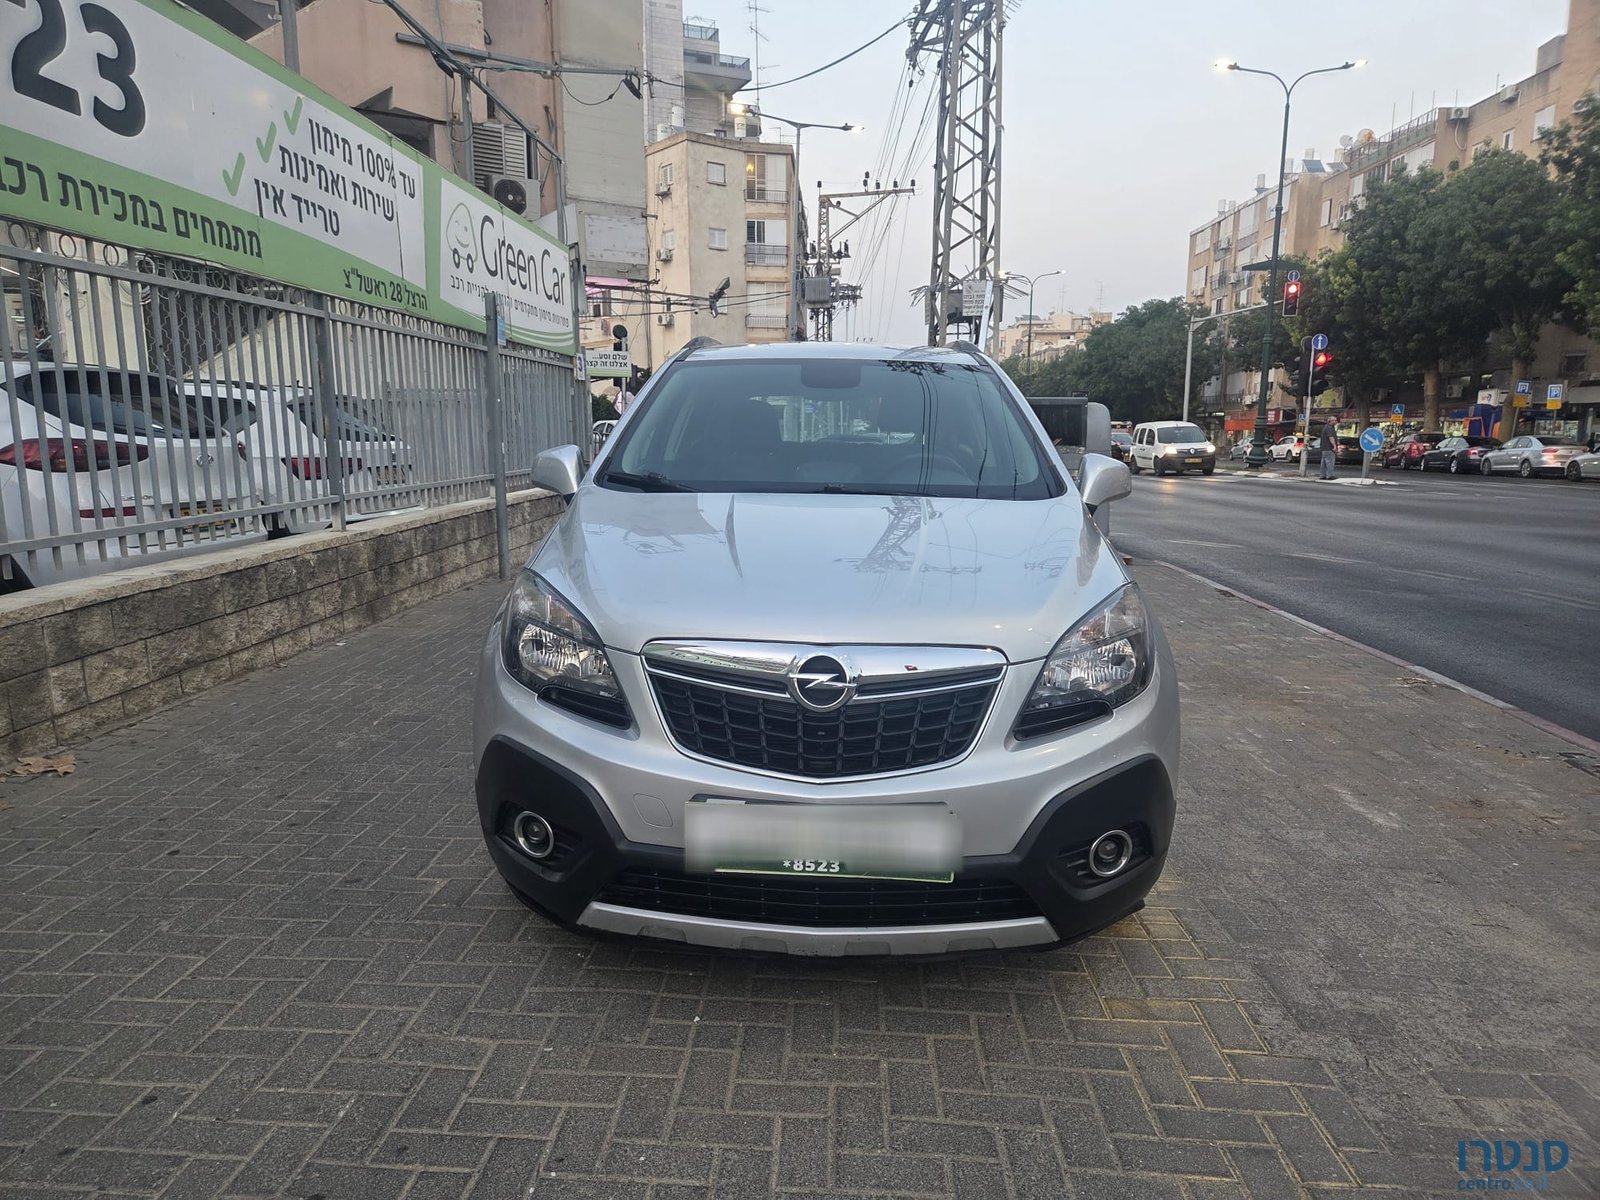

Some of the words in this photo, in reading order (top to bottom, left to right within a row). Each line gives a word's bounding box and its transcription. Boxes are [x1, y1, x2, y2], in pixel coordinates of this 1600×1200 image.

[0, 0, 146, 137] 23
[308, 118, 353, 166] מימון
[279, 145, 348, 201] ואמינות
[357, 143, 397, 189] 100%
[399, 170, 416, 199] עד
[57, 172, 168, 233] במכירת
[254, 178, 288, 218] אין
[291, 193, 340, 236] טרייד
[351, 181, 395, 222] שירות
[172, 206, 263, 259] מתמחים
[480, 215, 538, 295] Green
[541, 249, 566, 305] Car
[389, 280, 403, 303] 28
[404, 284, 428, 311] הרצל
[450, 275, 465, 292] רכב
[609, 360, 628, 368] אצלנו
